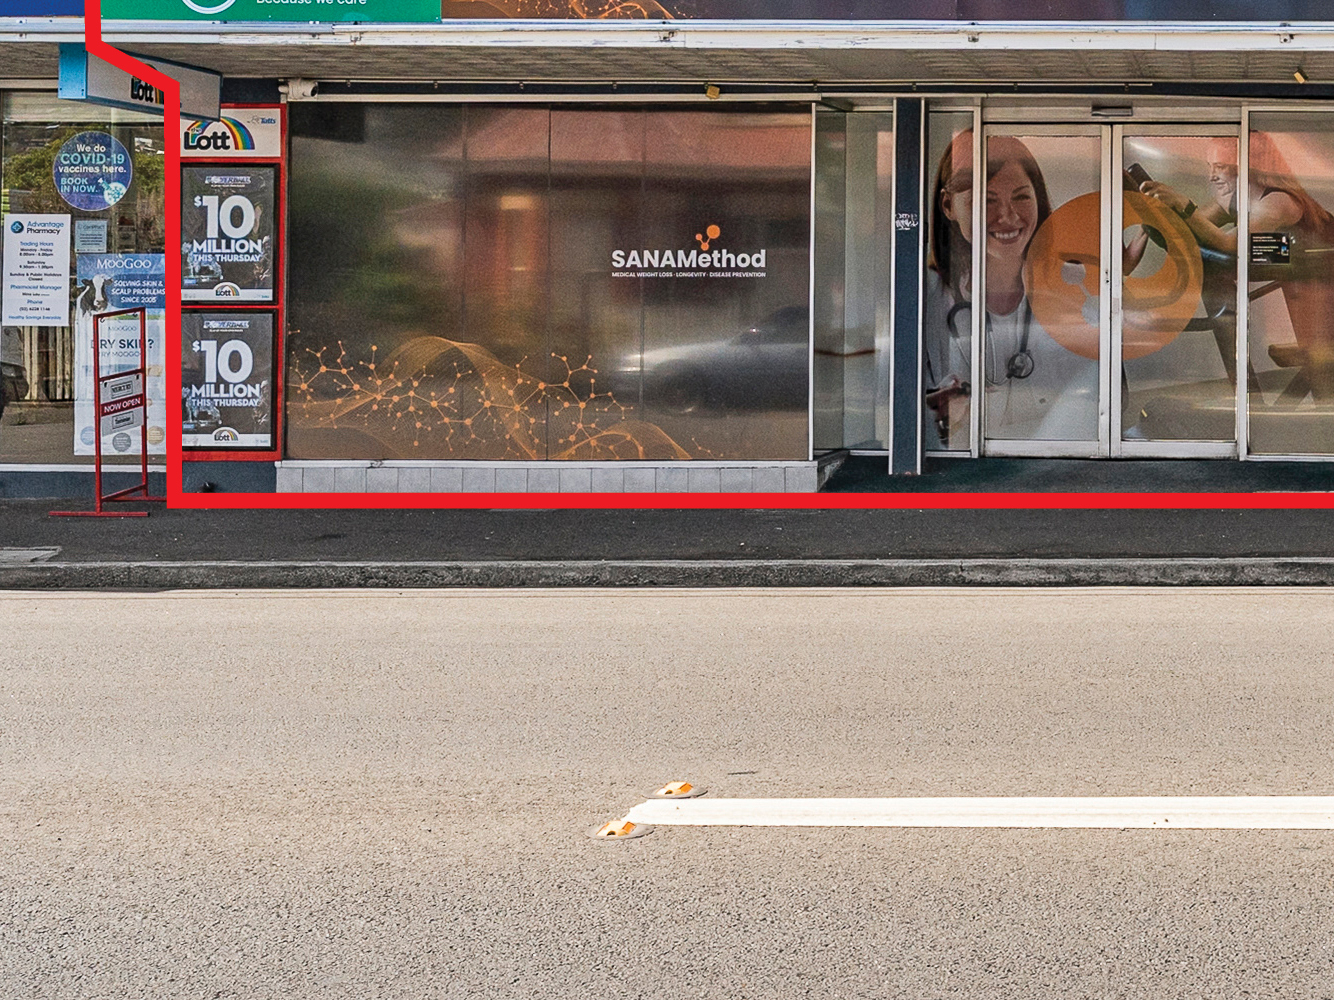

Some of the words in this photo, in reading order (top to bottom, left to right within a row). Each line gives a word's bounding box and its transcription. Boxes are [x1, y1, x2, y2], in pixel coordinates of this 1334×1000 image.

[184, 131, 230, 150] Lott
[77, 144, 91, 152] We
[94, 144, 106, 152] do
[60, 153, 125, 164] COVID-19
[58, 165, 100, 173] vaccines
[102, 165, 127, 173] here.
[194, 195, 255, 239] $10
[27, 221, 64, 229] Advantage
[193, 239, 262, 253] MILLION
[216, 254, 261, 262] THURSDAY
[612, 249, 766, 268] SANAMethod
[192, 340, 254, 383] $10
[192, 384, 261, 398] MILLION
[104, 401, 121, 413] NOW
[122, 397, 140, 408] OPEN
[214, 399, 260, 407] THURSDAY
